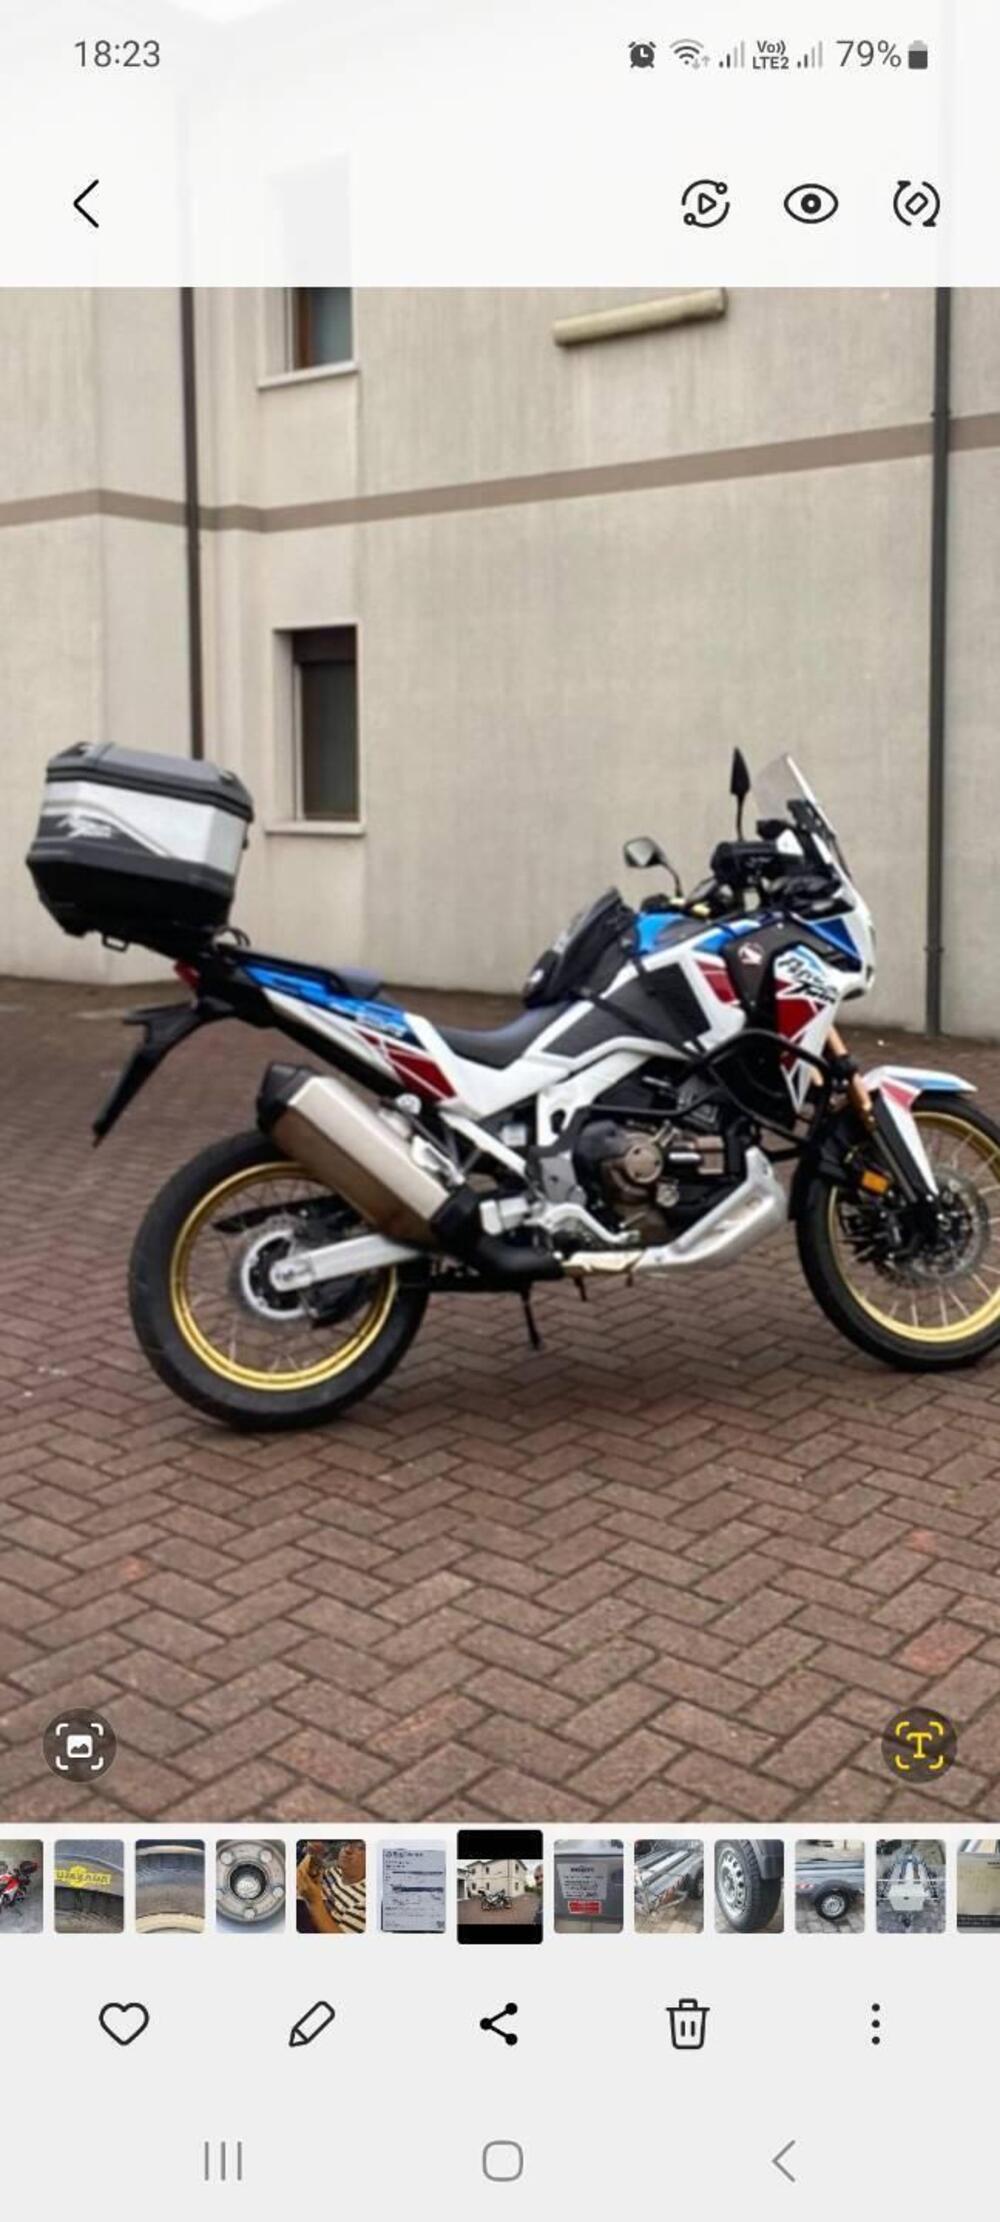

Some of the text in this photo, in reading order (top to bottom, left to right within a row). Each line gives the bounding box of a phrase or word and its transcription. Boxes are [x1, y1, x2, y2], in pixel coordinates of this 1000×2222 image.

[74, 39, 161, 68] 18:23
[752, 56, 789, 70] LTE2
[836, 39, 902, 68] 79%
